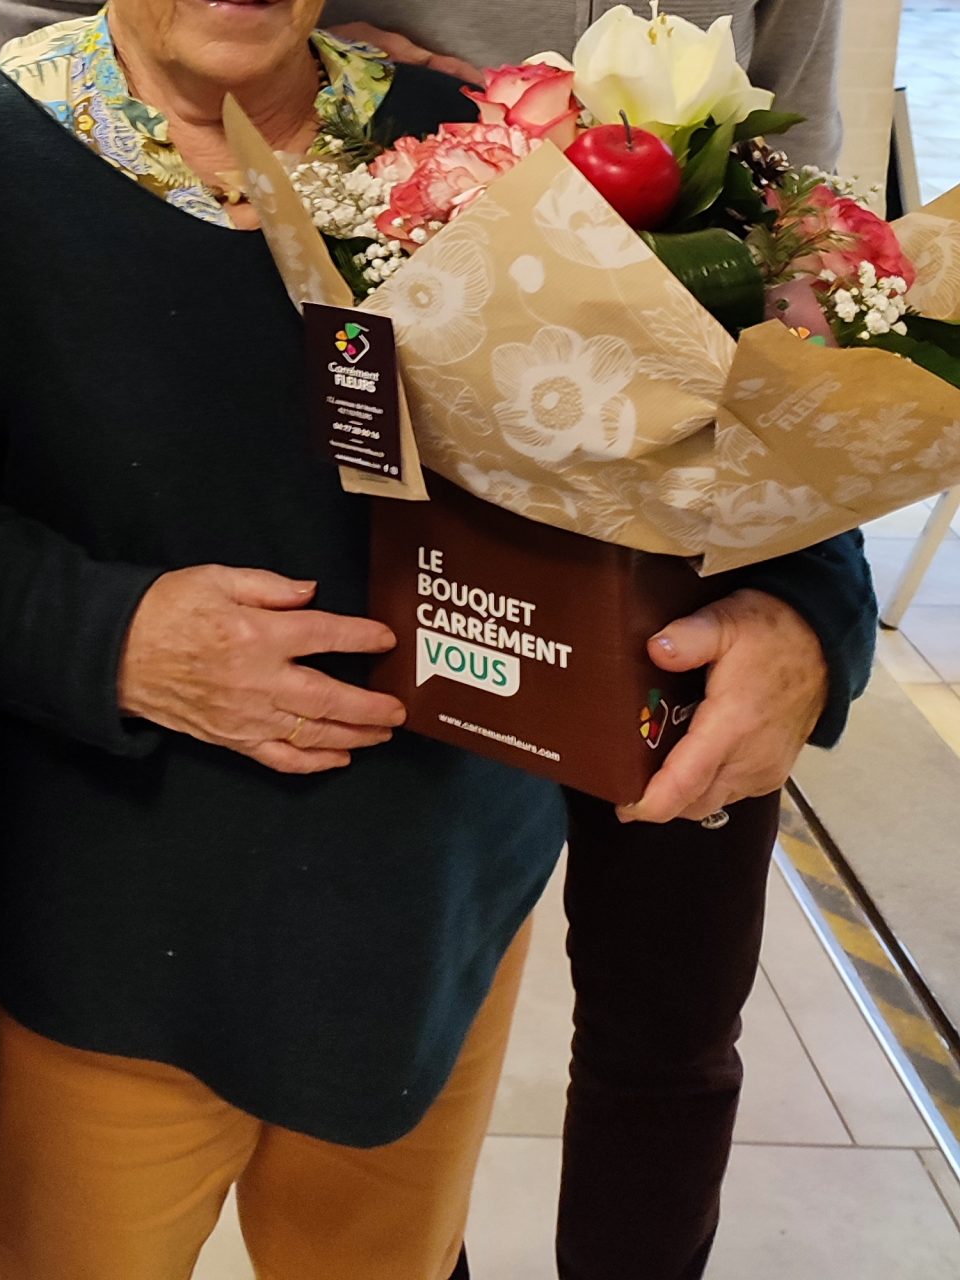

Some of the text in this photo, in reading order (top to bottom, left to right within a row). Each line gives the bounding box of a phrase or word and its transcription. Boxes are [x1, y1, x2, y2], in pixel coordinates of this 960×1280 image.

[334, 373, 376, 393] FLEURS
[418, 546, 443, 573] LE
[418, 573, 536, 626] BOUQUET
[417, 603, 572, 669] CARRÉMENT
[424, 637, 508, 687] VOUS
